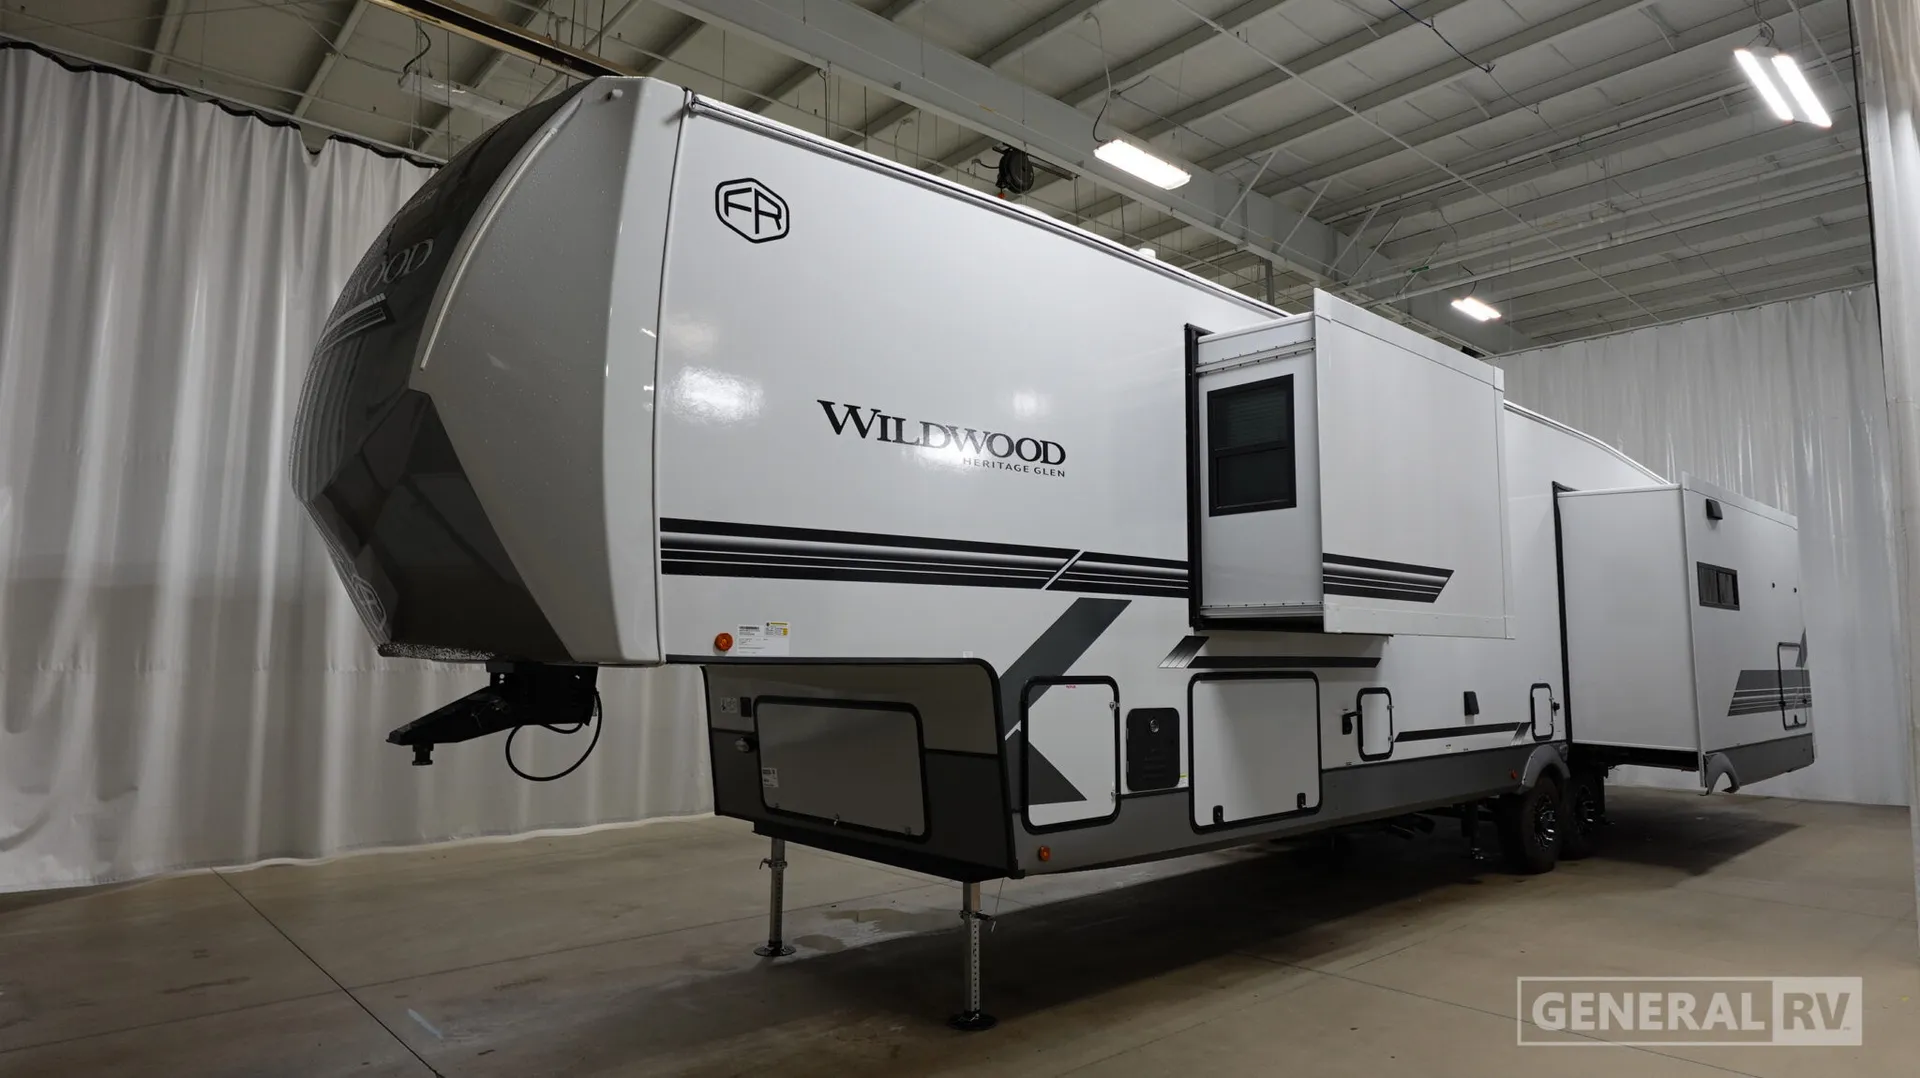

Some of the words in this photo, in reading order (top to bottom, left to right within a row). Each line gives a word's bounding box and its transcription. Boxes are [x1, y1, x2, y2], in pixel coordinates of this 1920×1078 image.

[723, 187, 782, 235] FR
[816, 399, 1066, 466] WILDWOOD
[963, 457, 1030, 474] HERITAGE
[1033, 466, 1066, 478] GLEN
